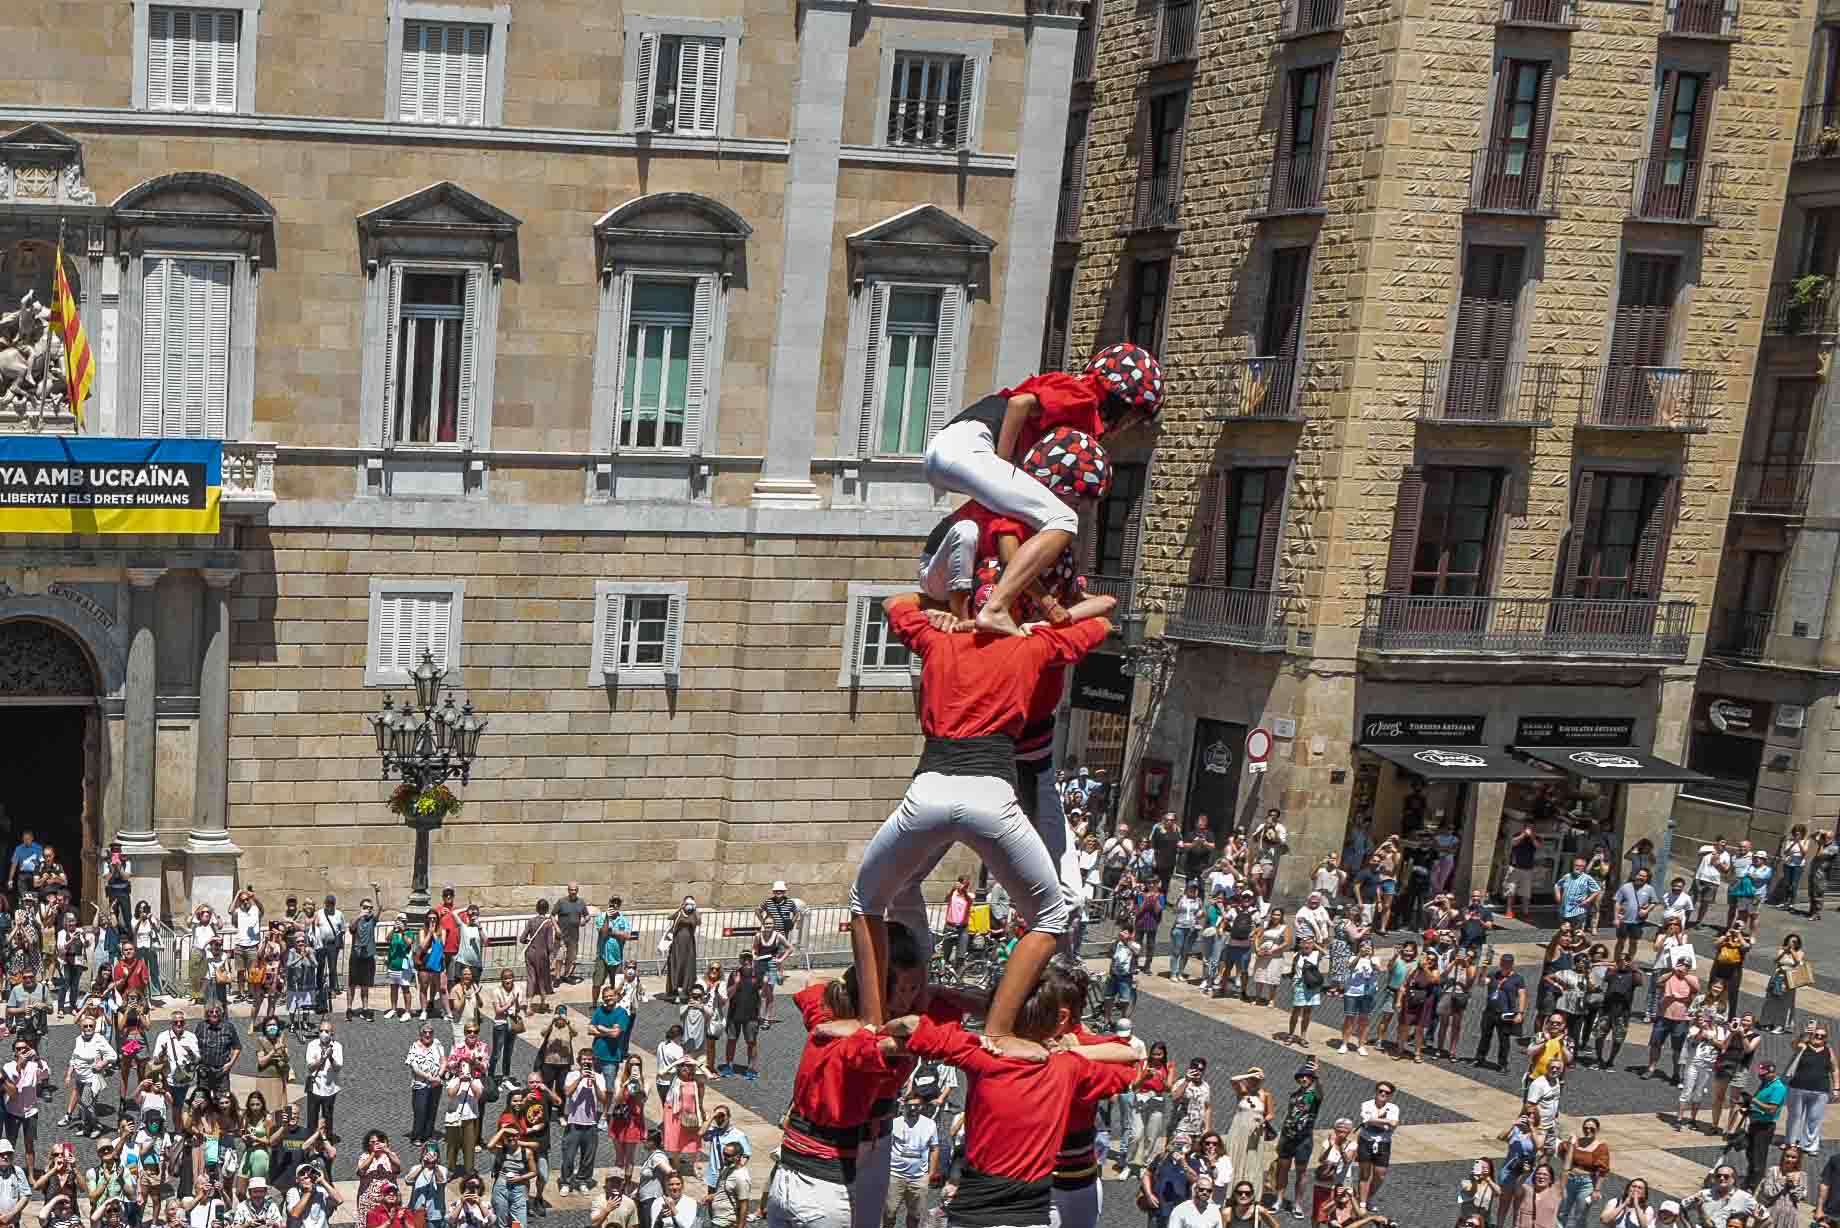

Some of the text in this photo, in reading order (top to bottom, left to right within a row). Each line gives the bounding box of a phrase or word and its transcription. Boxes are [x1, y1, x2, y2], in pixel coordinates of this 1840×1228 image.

[34, 468, 84, 486] AMB
[90, 465, 190, 487] UCRAÏNA
[68, 494, 92, 504] ELS
[94, 494, 134, 504] DRETS
[137, 494, 190, 505] HUMANS
